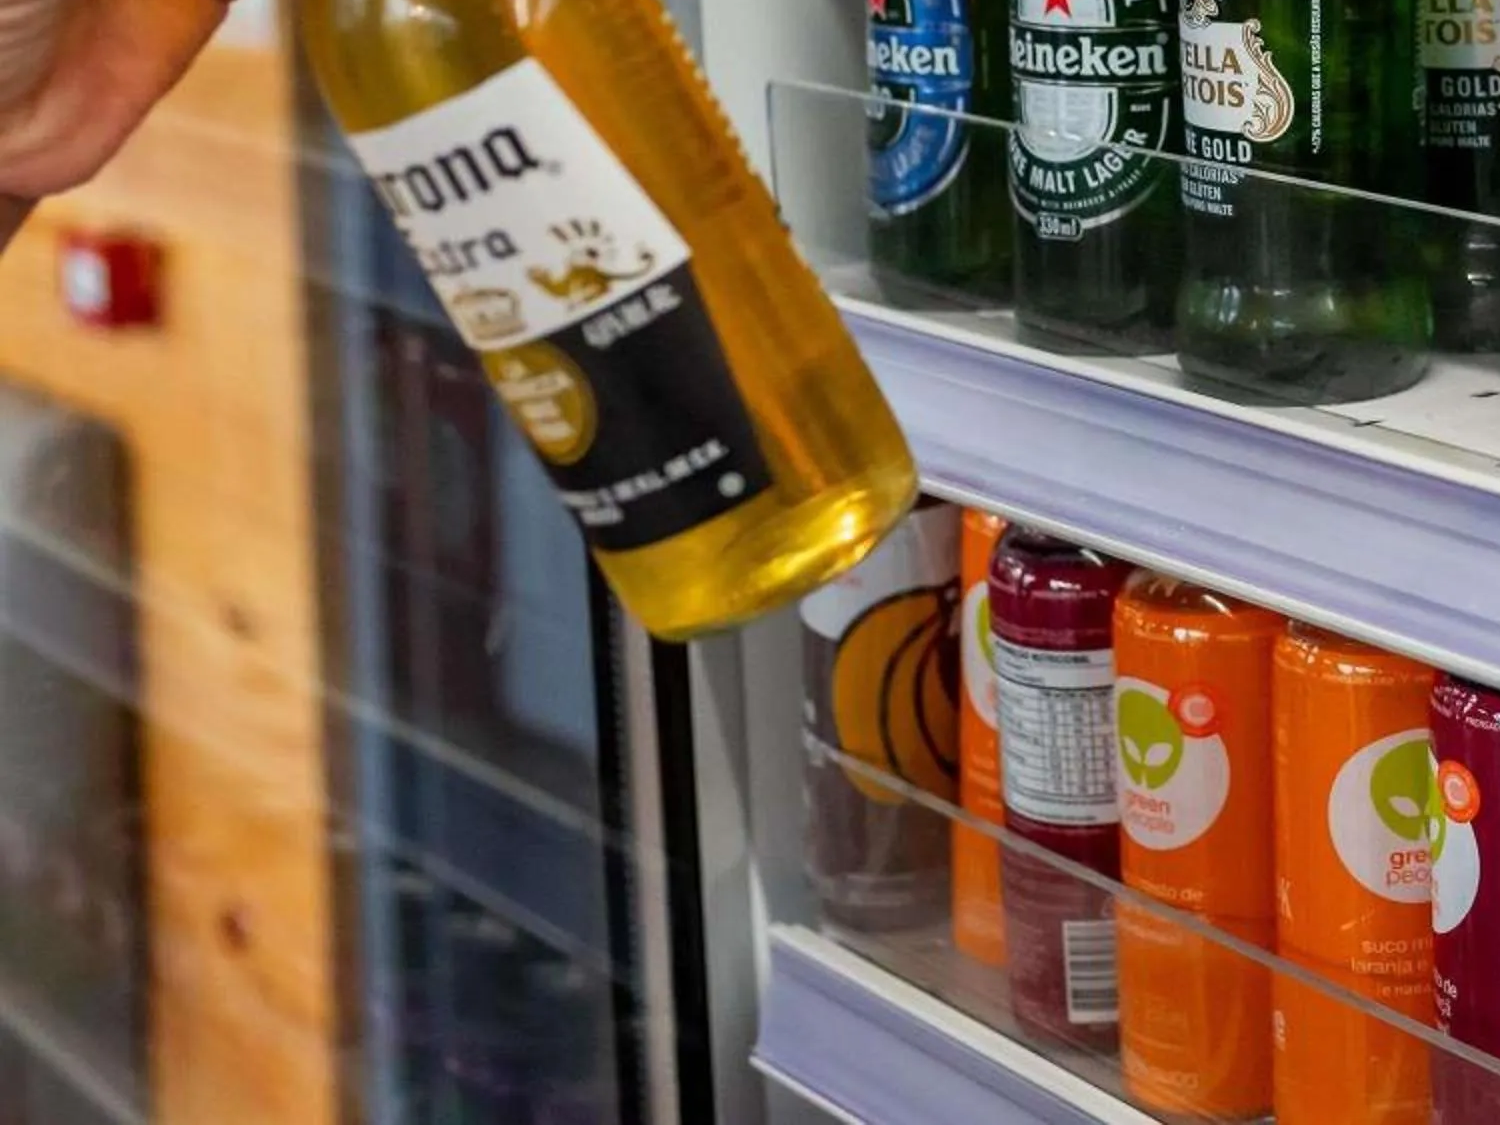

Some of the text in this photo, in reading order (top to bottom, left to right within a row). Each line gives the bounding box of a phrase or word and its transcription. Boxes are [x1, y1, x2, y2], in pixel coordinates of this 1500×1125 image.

[1029, 165, 1076, 195] MALT
[1082, 128, 1149, 189] LAGER
[1201, 135, 1253, 164] GOLD
[1361, 938, 1408, 955] suco
